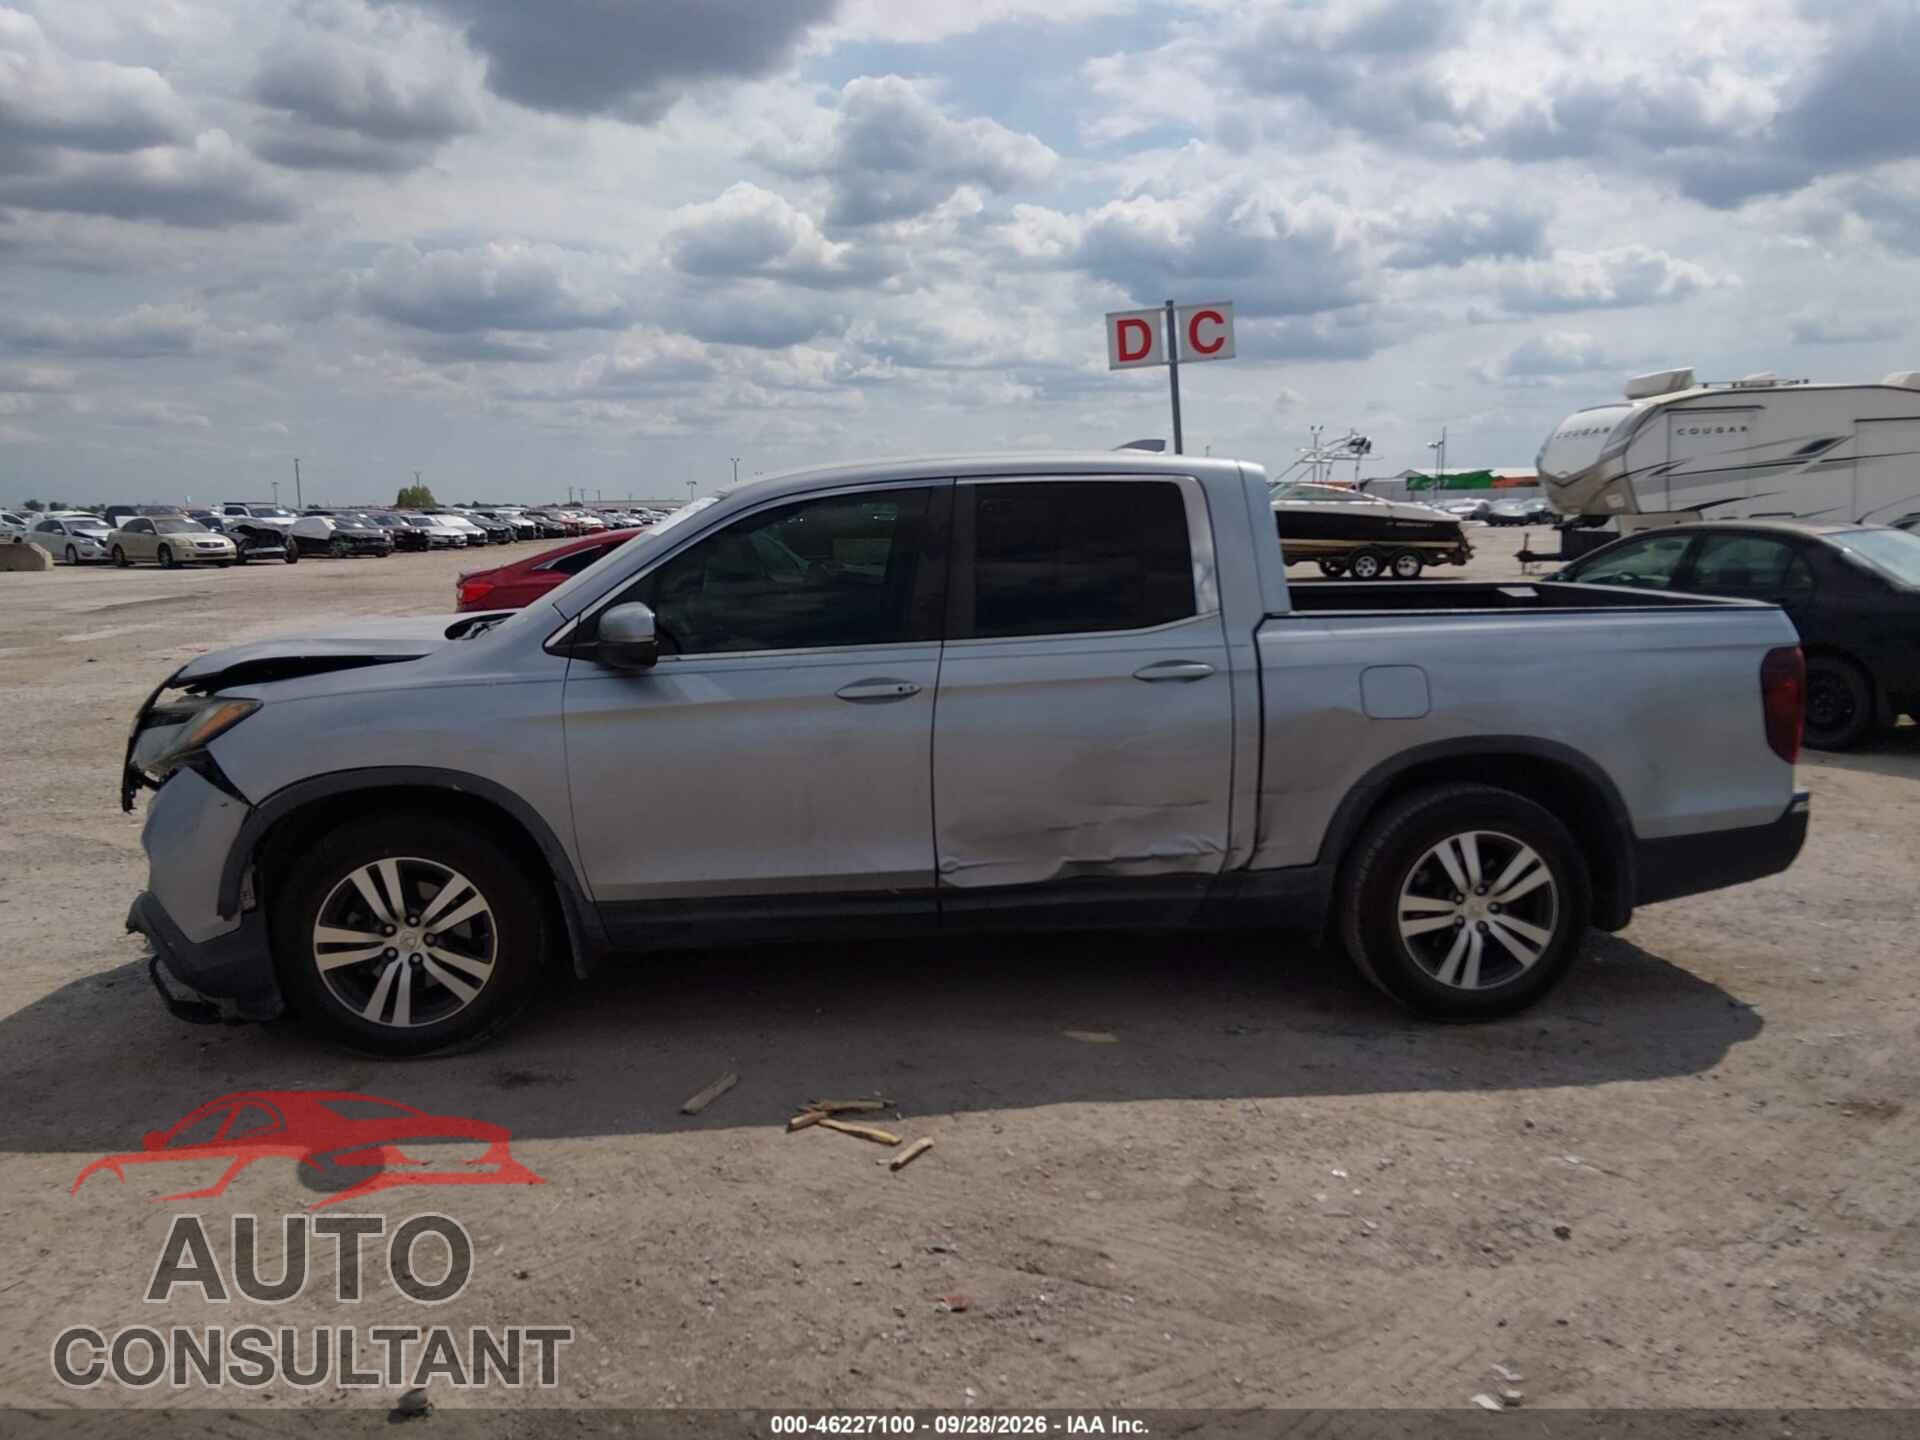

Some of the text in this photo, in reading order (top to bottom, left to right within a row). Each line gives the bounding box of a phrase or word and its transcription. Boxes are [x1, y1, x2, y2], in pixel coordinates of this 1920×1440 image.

[1116, 318, 1152, 362] D
[1189, 310, 1225, 354] C
[1677, 426, 1749, 436] COUGAR
